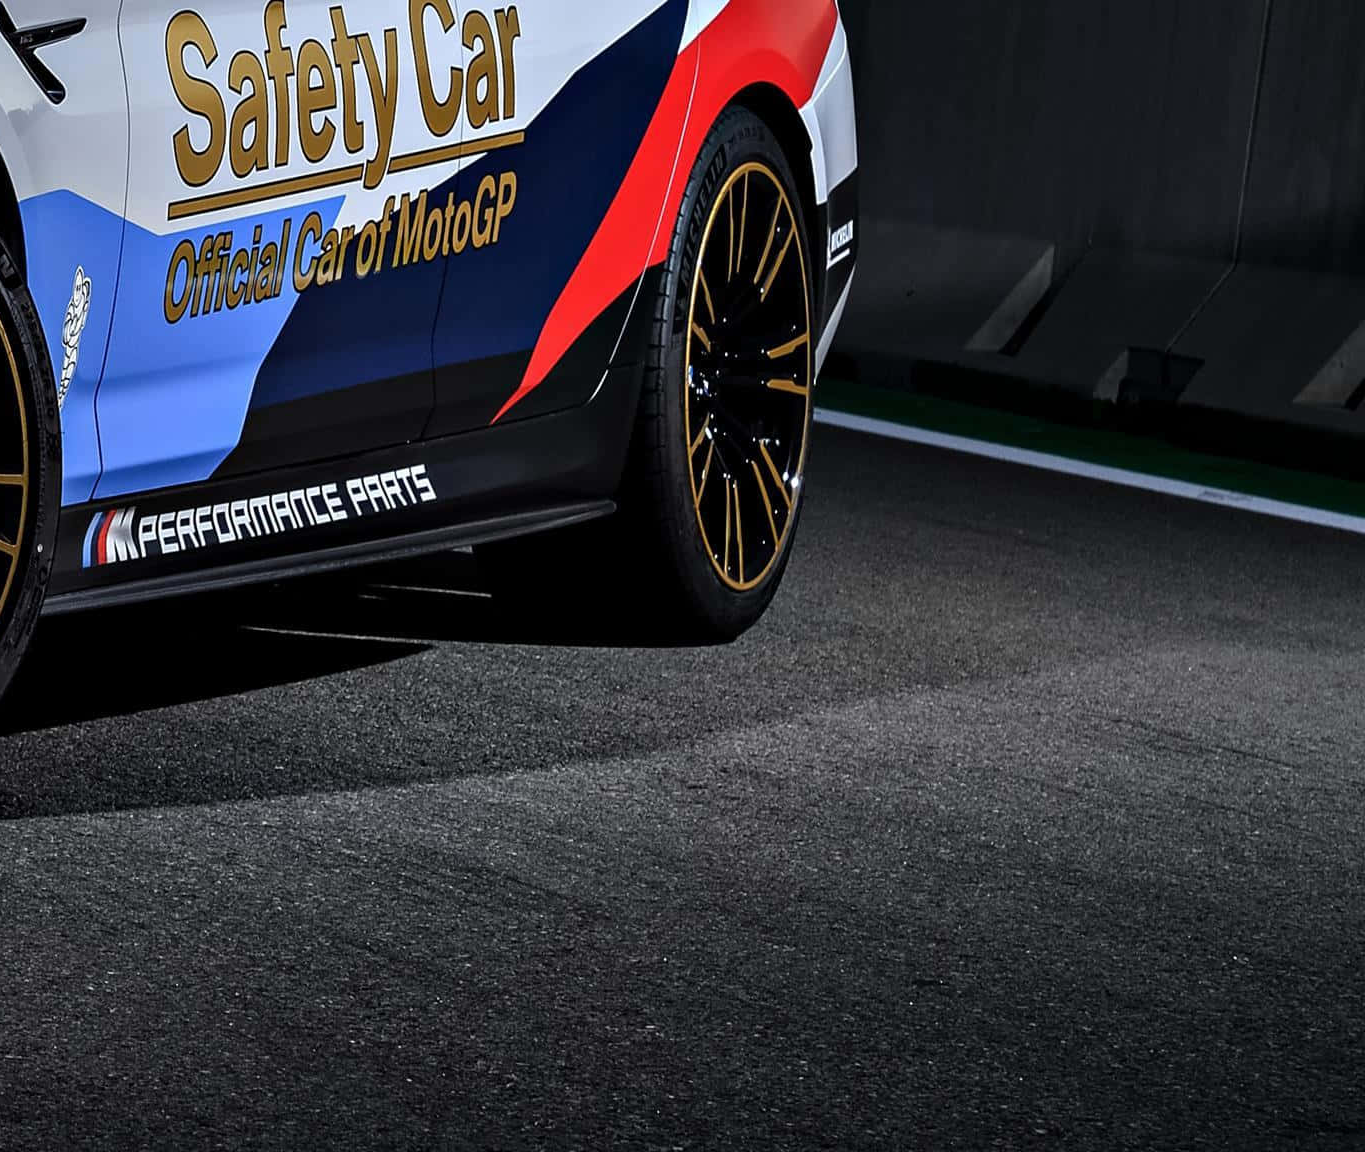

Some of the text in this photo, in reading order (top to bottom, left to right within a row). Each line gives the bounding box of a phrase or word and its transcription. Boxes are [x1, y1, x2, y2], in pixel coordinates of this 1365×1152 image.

[164, 171, 518, 324] Official Car of MotoGP
[137, 483, 349, 559] PERFORMANCE
[346, 464, 438, 517] PARTS
